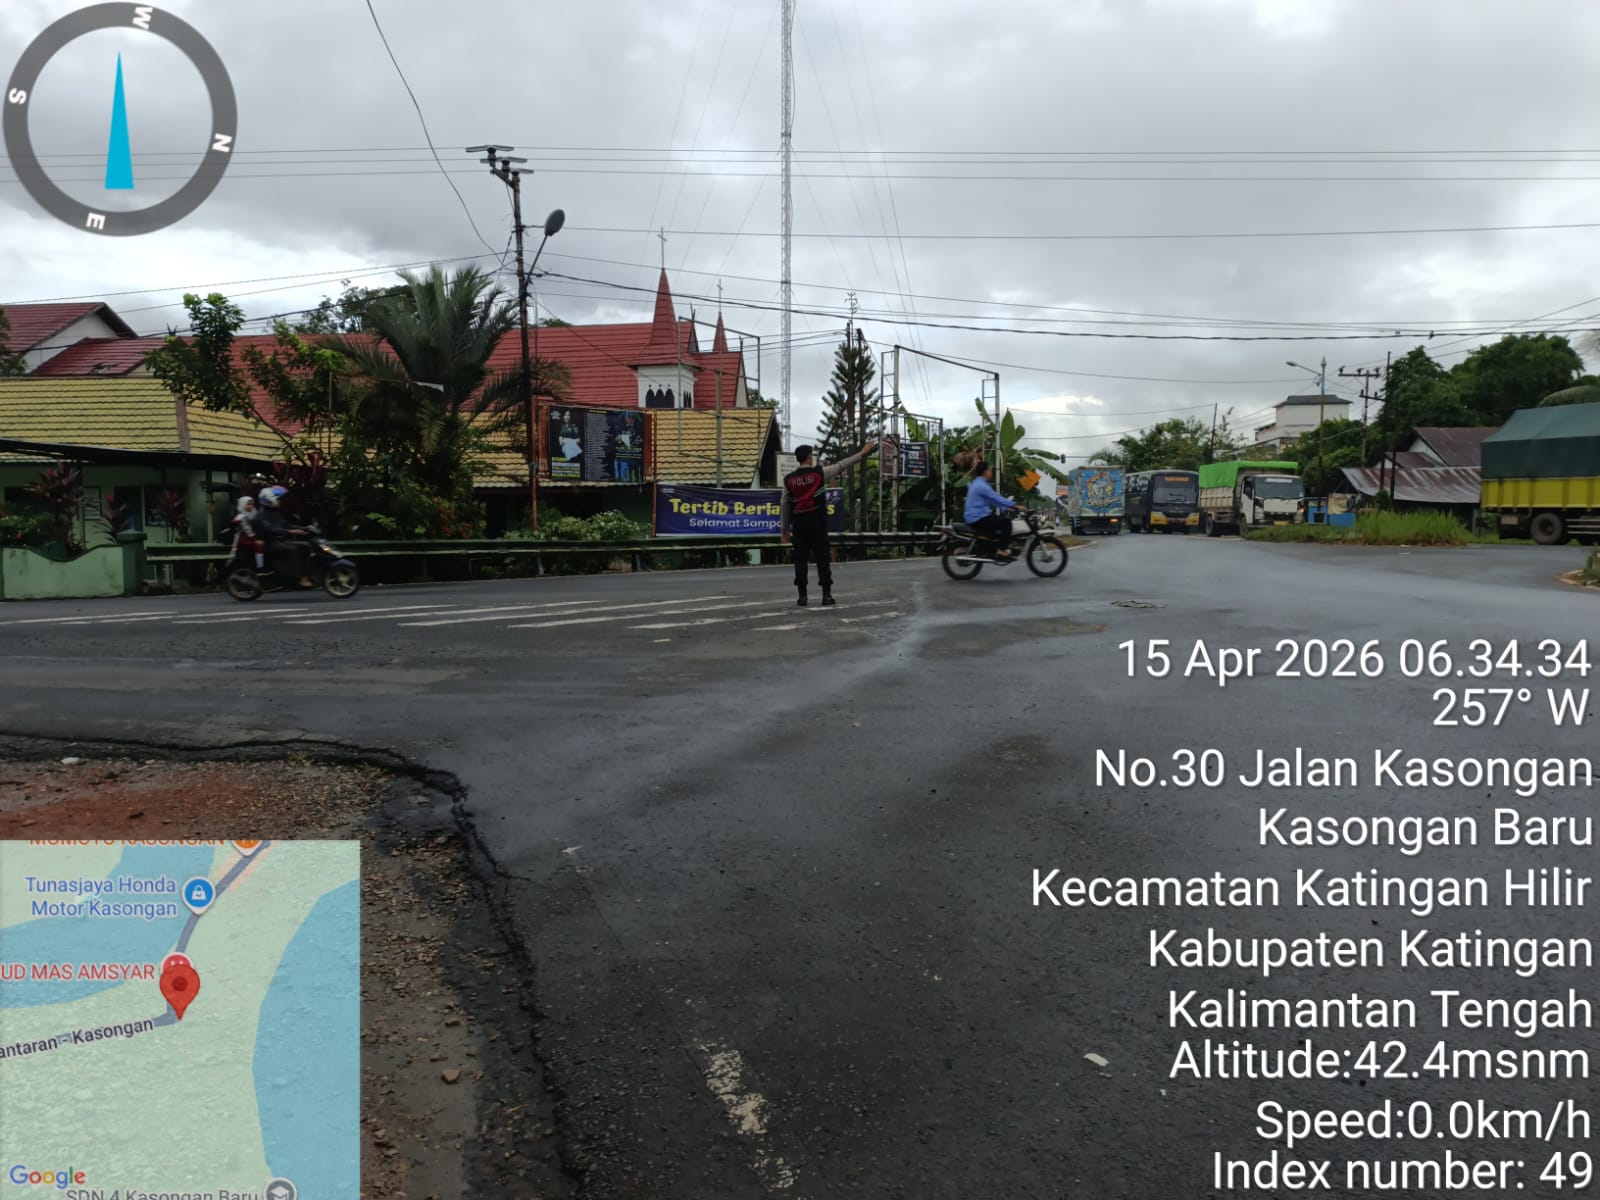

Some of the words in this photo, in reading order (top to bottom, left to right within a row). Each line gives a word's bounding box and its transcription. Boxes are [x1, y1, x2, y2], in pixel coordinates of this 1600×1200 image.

[669, 498, 729, 515] Tertib
[734, 501, 781, 516] Berla
[689, 518, 740, 528] Selamat
[743, 518, 782, 530] Sampa
